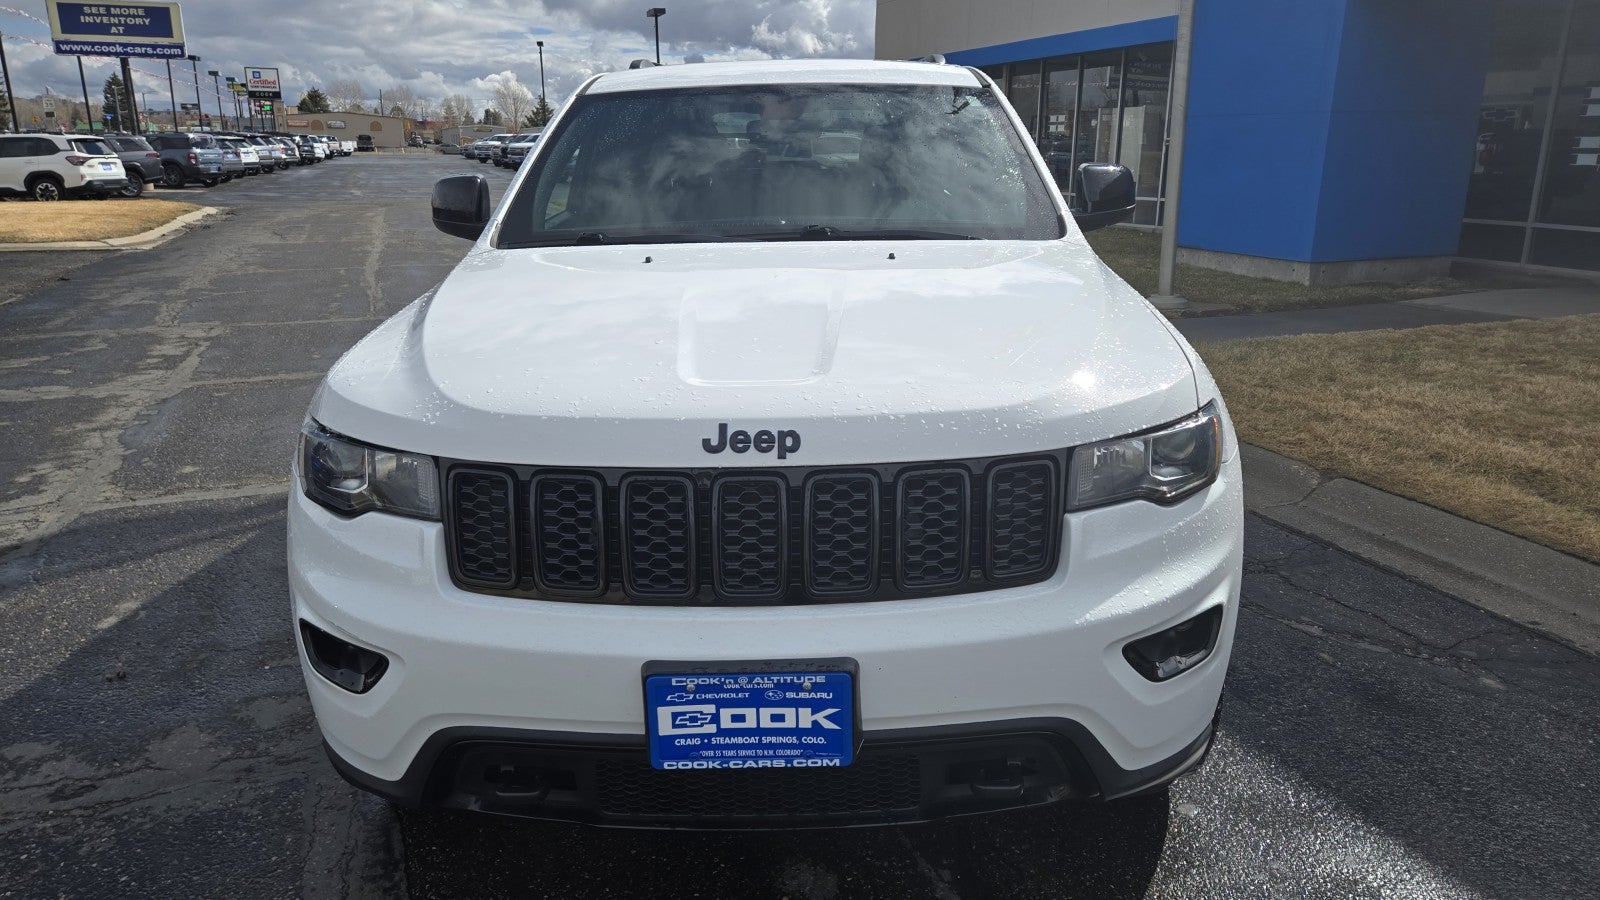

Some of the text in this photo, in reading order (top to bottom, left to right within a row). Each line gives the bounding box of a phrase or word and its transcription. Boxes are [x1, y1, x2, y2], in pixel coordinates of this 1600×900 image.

[83, 6, 145, 15] SEE MORE
[80, 15, 151, 25] INVENTORY
[110, 26, 125, 34] AT
[59, 43, 182, 55] www.cook-cars.com
[702, 423, 801, 459] Jeep
[752, 675, 826, 684] ALTITUDE
[785, 691, 833, 699] SUBARU
[657, 704, 842, 736] COOK
[674, 736, 827, 746] CRAIG STEAMBOAT SPRINGS, COLO.
[722, 749, 737, 757] YEARS
[738, 749, 756, 757] SERVICE
[663, 758, 841, 769] COOK-CARS.COM
